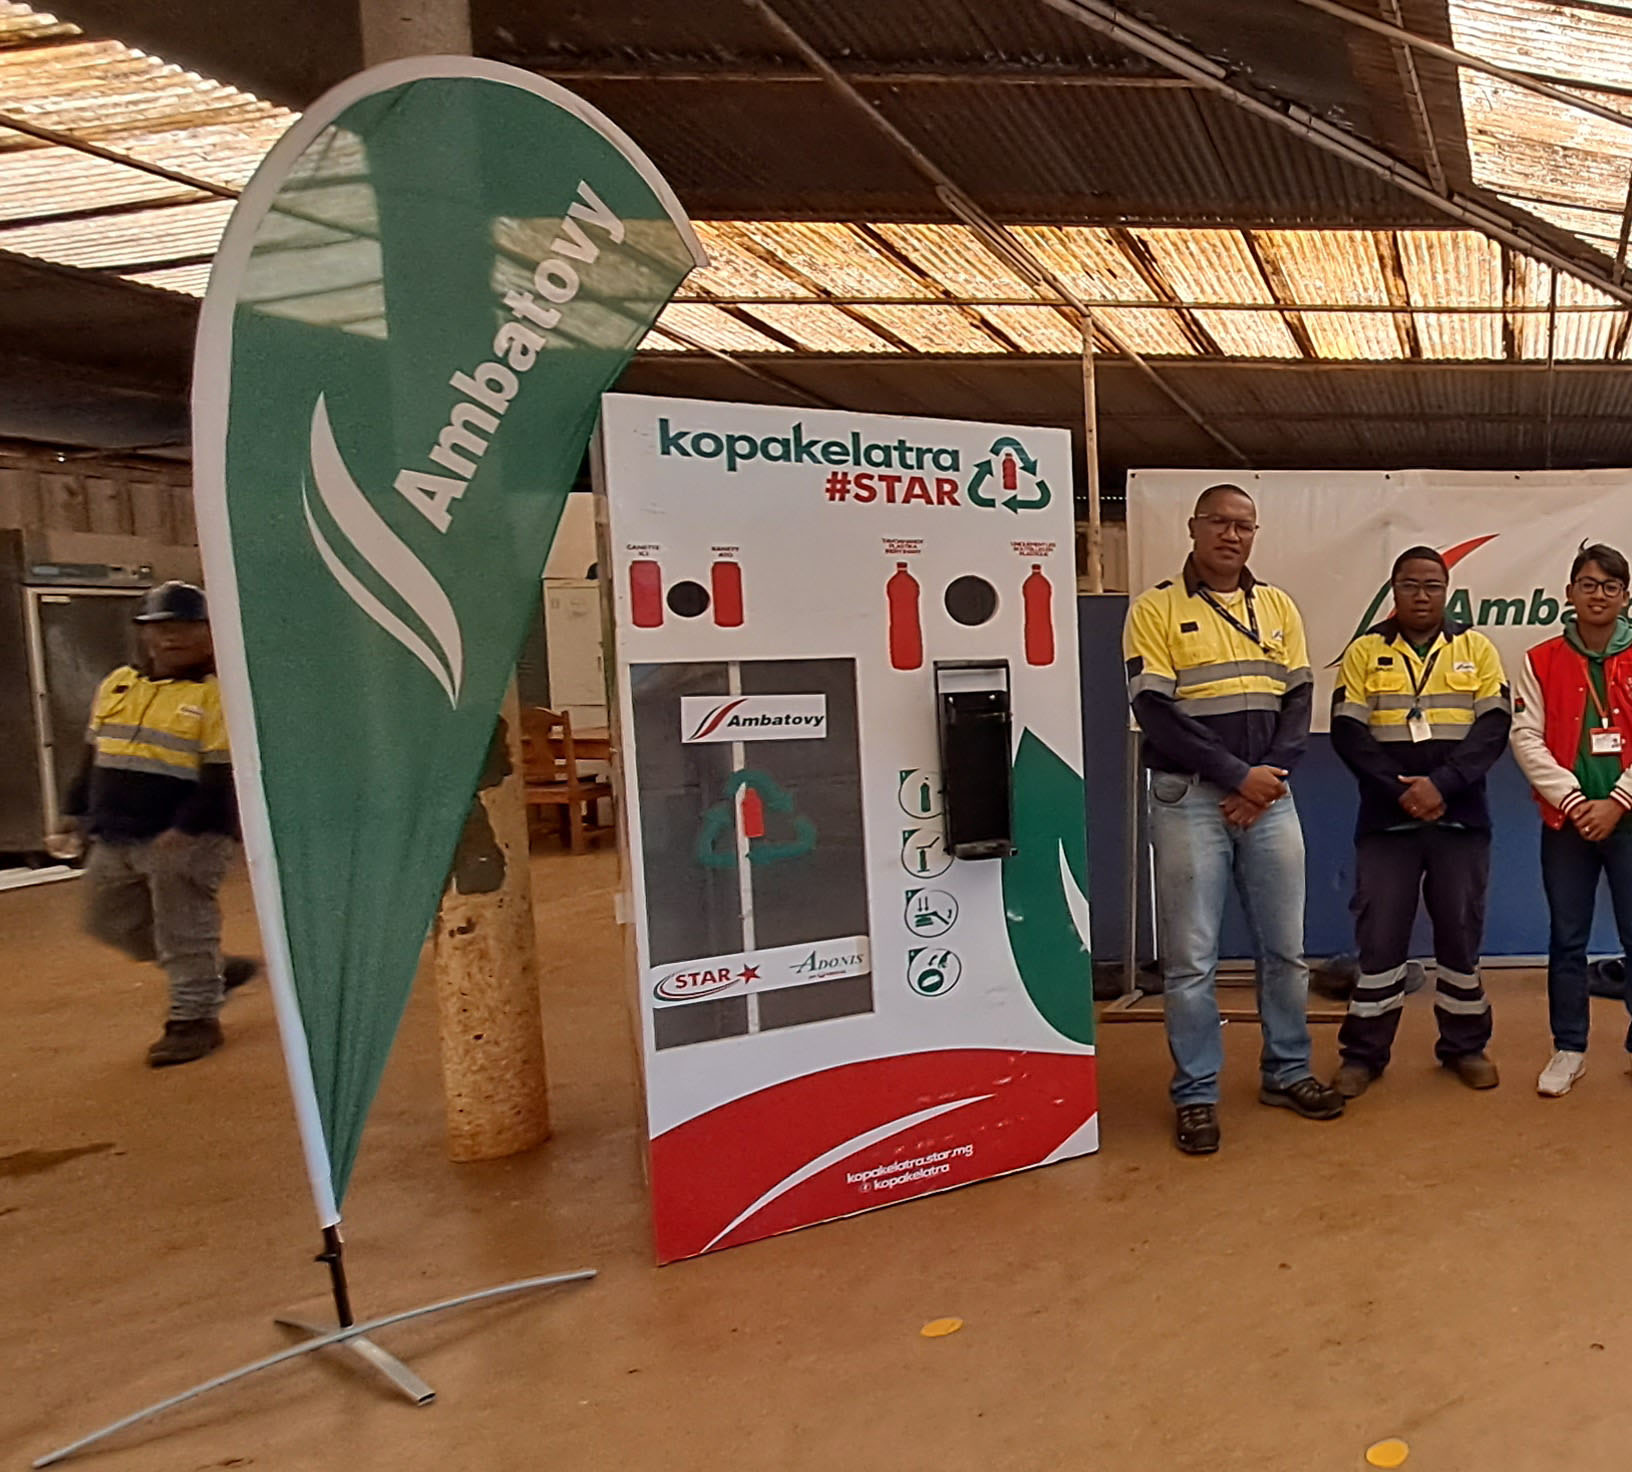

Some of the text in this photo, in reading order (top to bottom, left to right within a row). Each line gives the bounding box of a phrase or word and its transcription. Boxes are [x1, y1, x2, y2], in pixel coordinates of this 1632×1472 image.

[392, 180, 628, 534] Ambatovy
[658, 417, 961, 472] kopakelatra
[825, 471, 962, 506] #STAR
[727, 711, 825, 729] Ambatovy
[675, 967, 731, 989] STAR
[846, 1143, 974, 1184] kopakelatra.star.mg
[873, 1163, 950, 1190] kopakelatra
